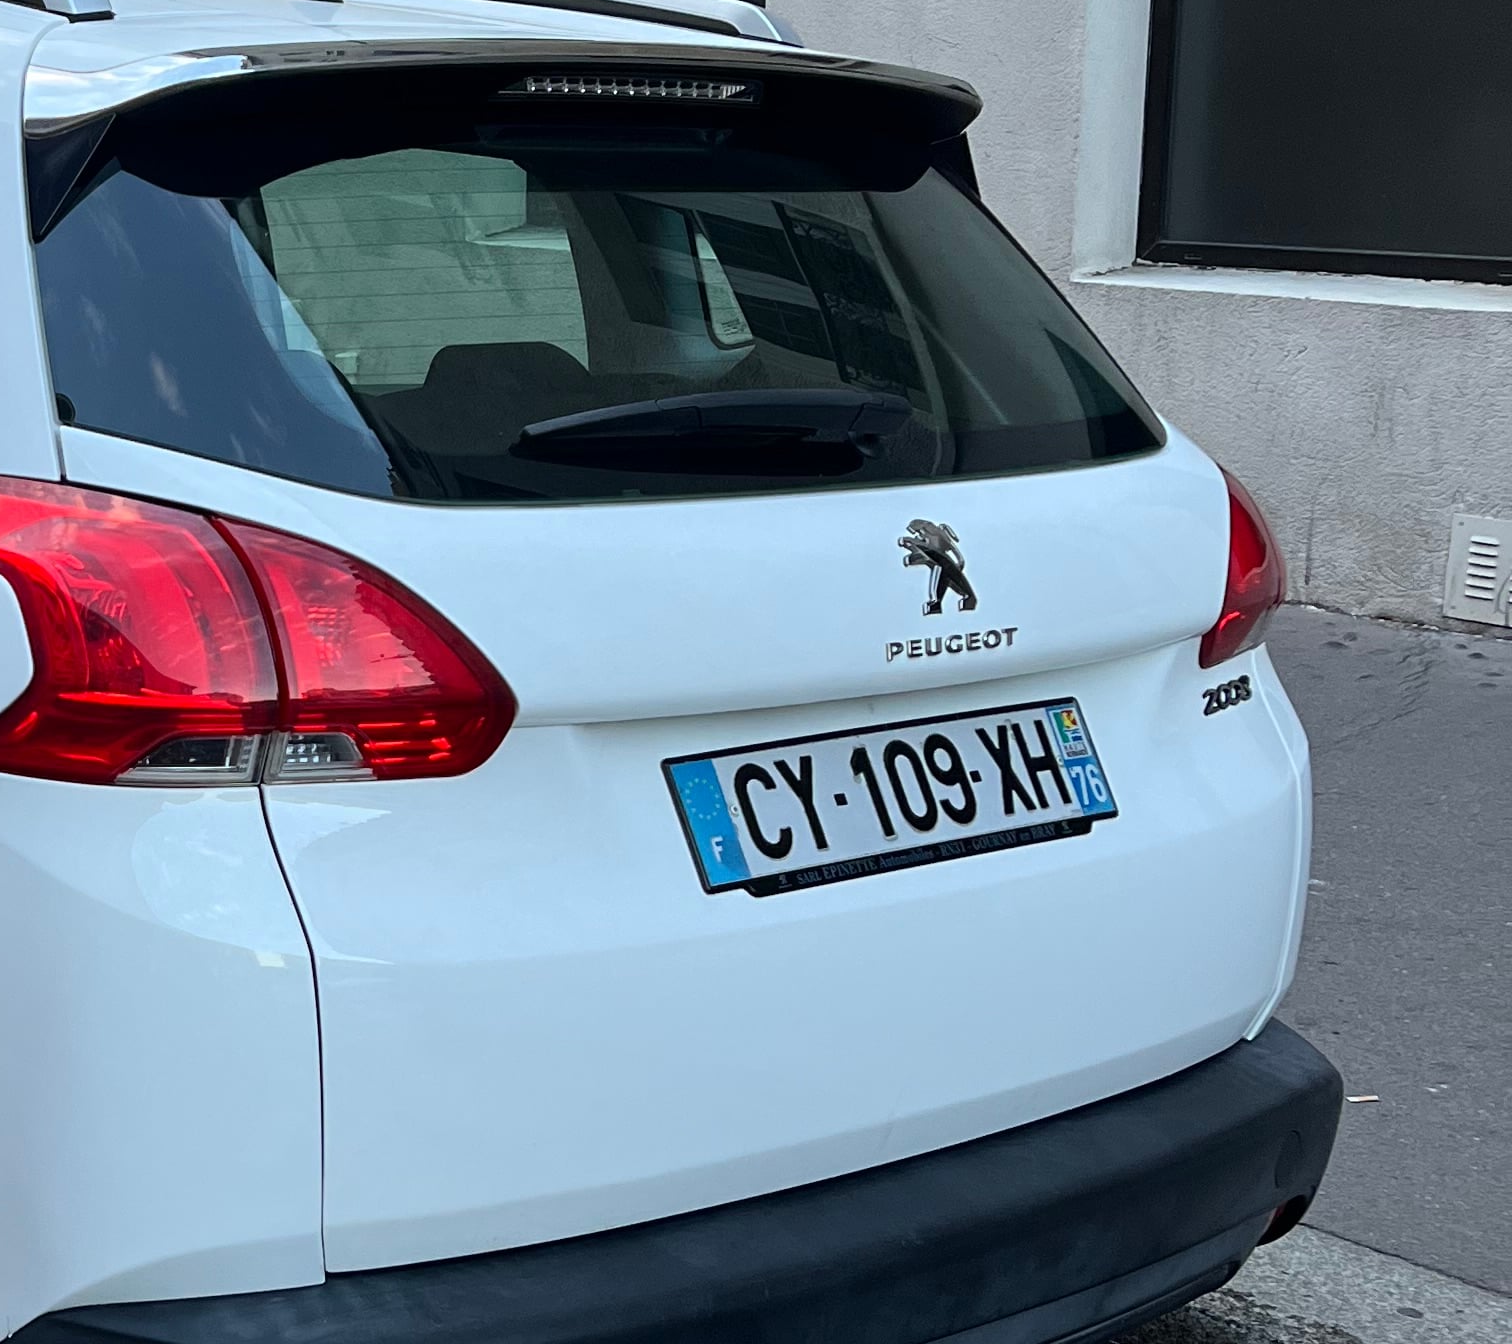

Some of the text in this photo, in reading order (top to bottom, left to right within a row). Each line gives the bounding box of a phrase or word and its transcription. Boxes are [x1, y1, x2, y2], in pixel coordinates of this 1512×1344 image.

[885, 627, 1019, 662] PEUGEOT
[1201, 674, 1252, 716] 2008
[734, 719, 1073, 860] CY-109-XH
[1068, 763, 1107, 806] 76
[710, 835, 724, 864] F
[796, 868, 822, 886] SARL
